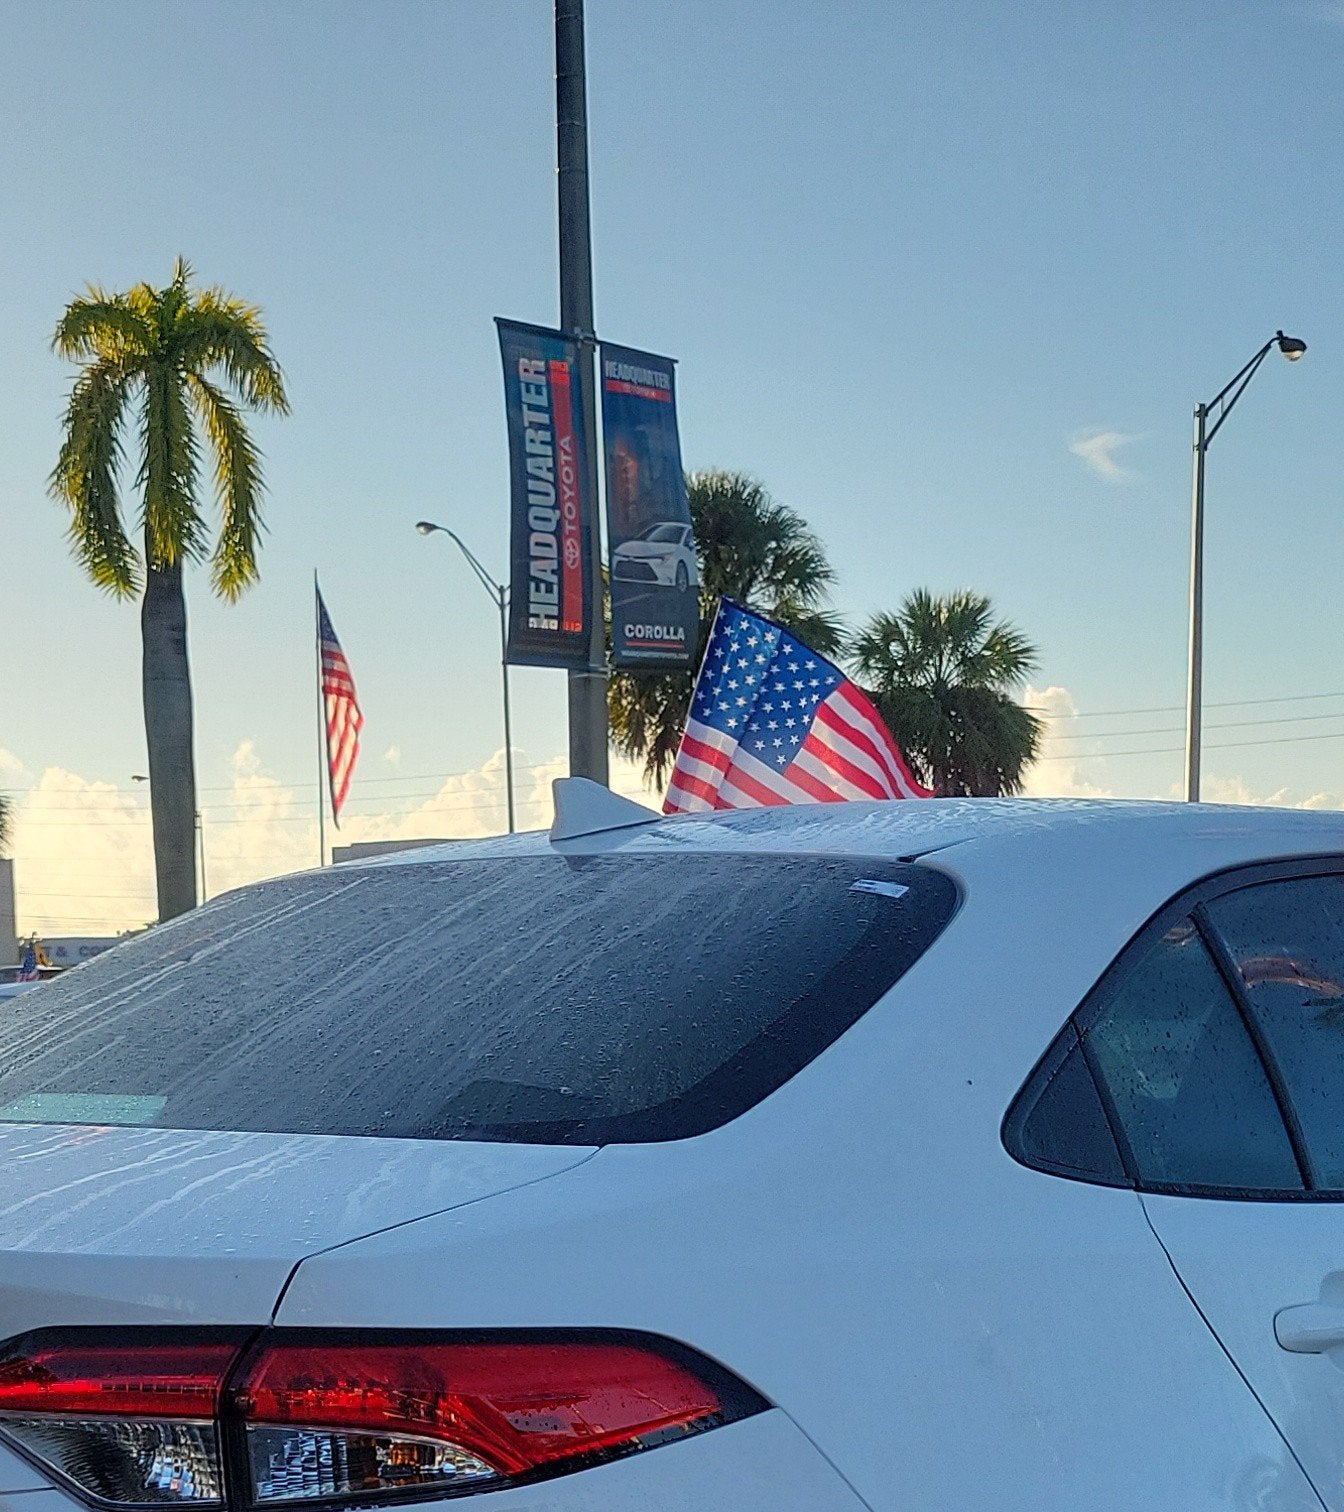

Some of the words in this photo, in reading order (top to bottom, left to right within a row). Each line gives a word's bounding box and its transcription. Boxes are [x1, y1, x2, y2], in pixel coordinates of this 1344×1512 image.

[518, 357, 559, 630] HEADQUARTER
[559, 436, 579, 533] TOYOTA
[624, 624, 685, 640] COROLLA
